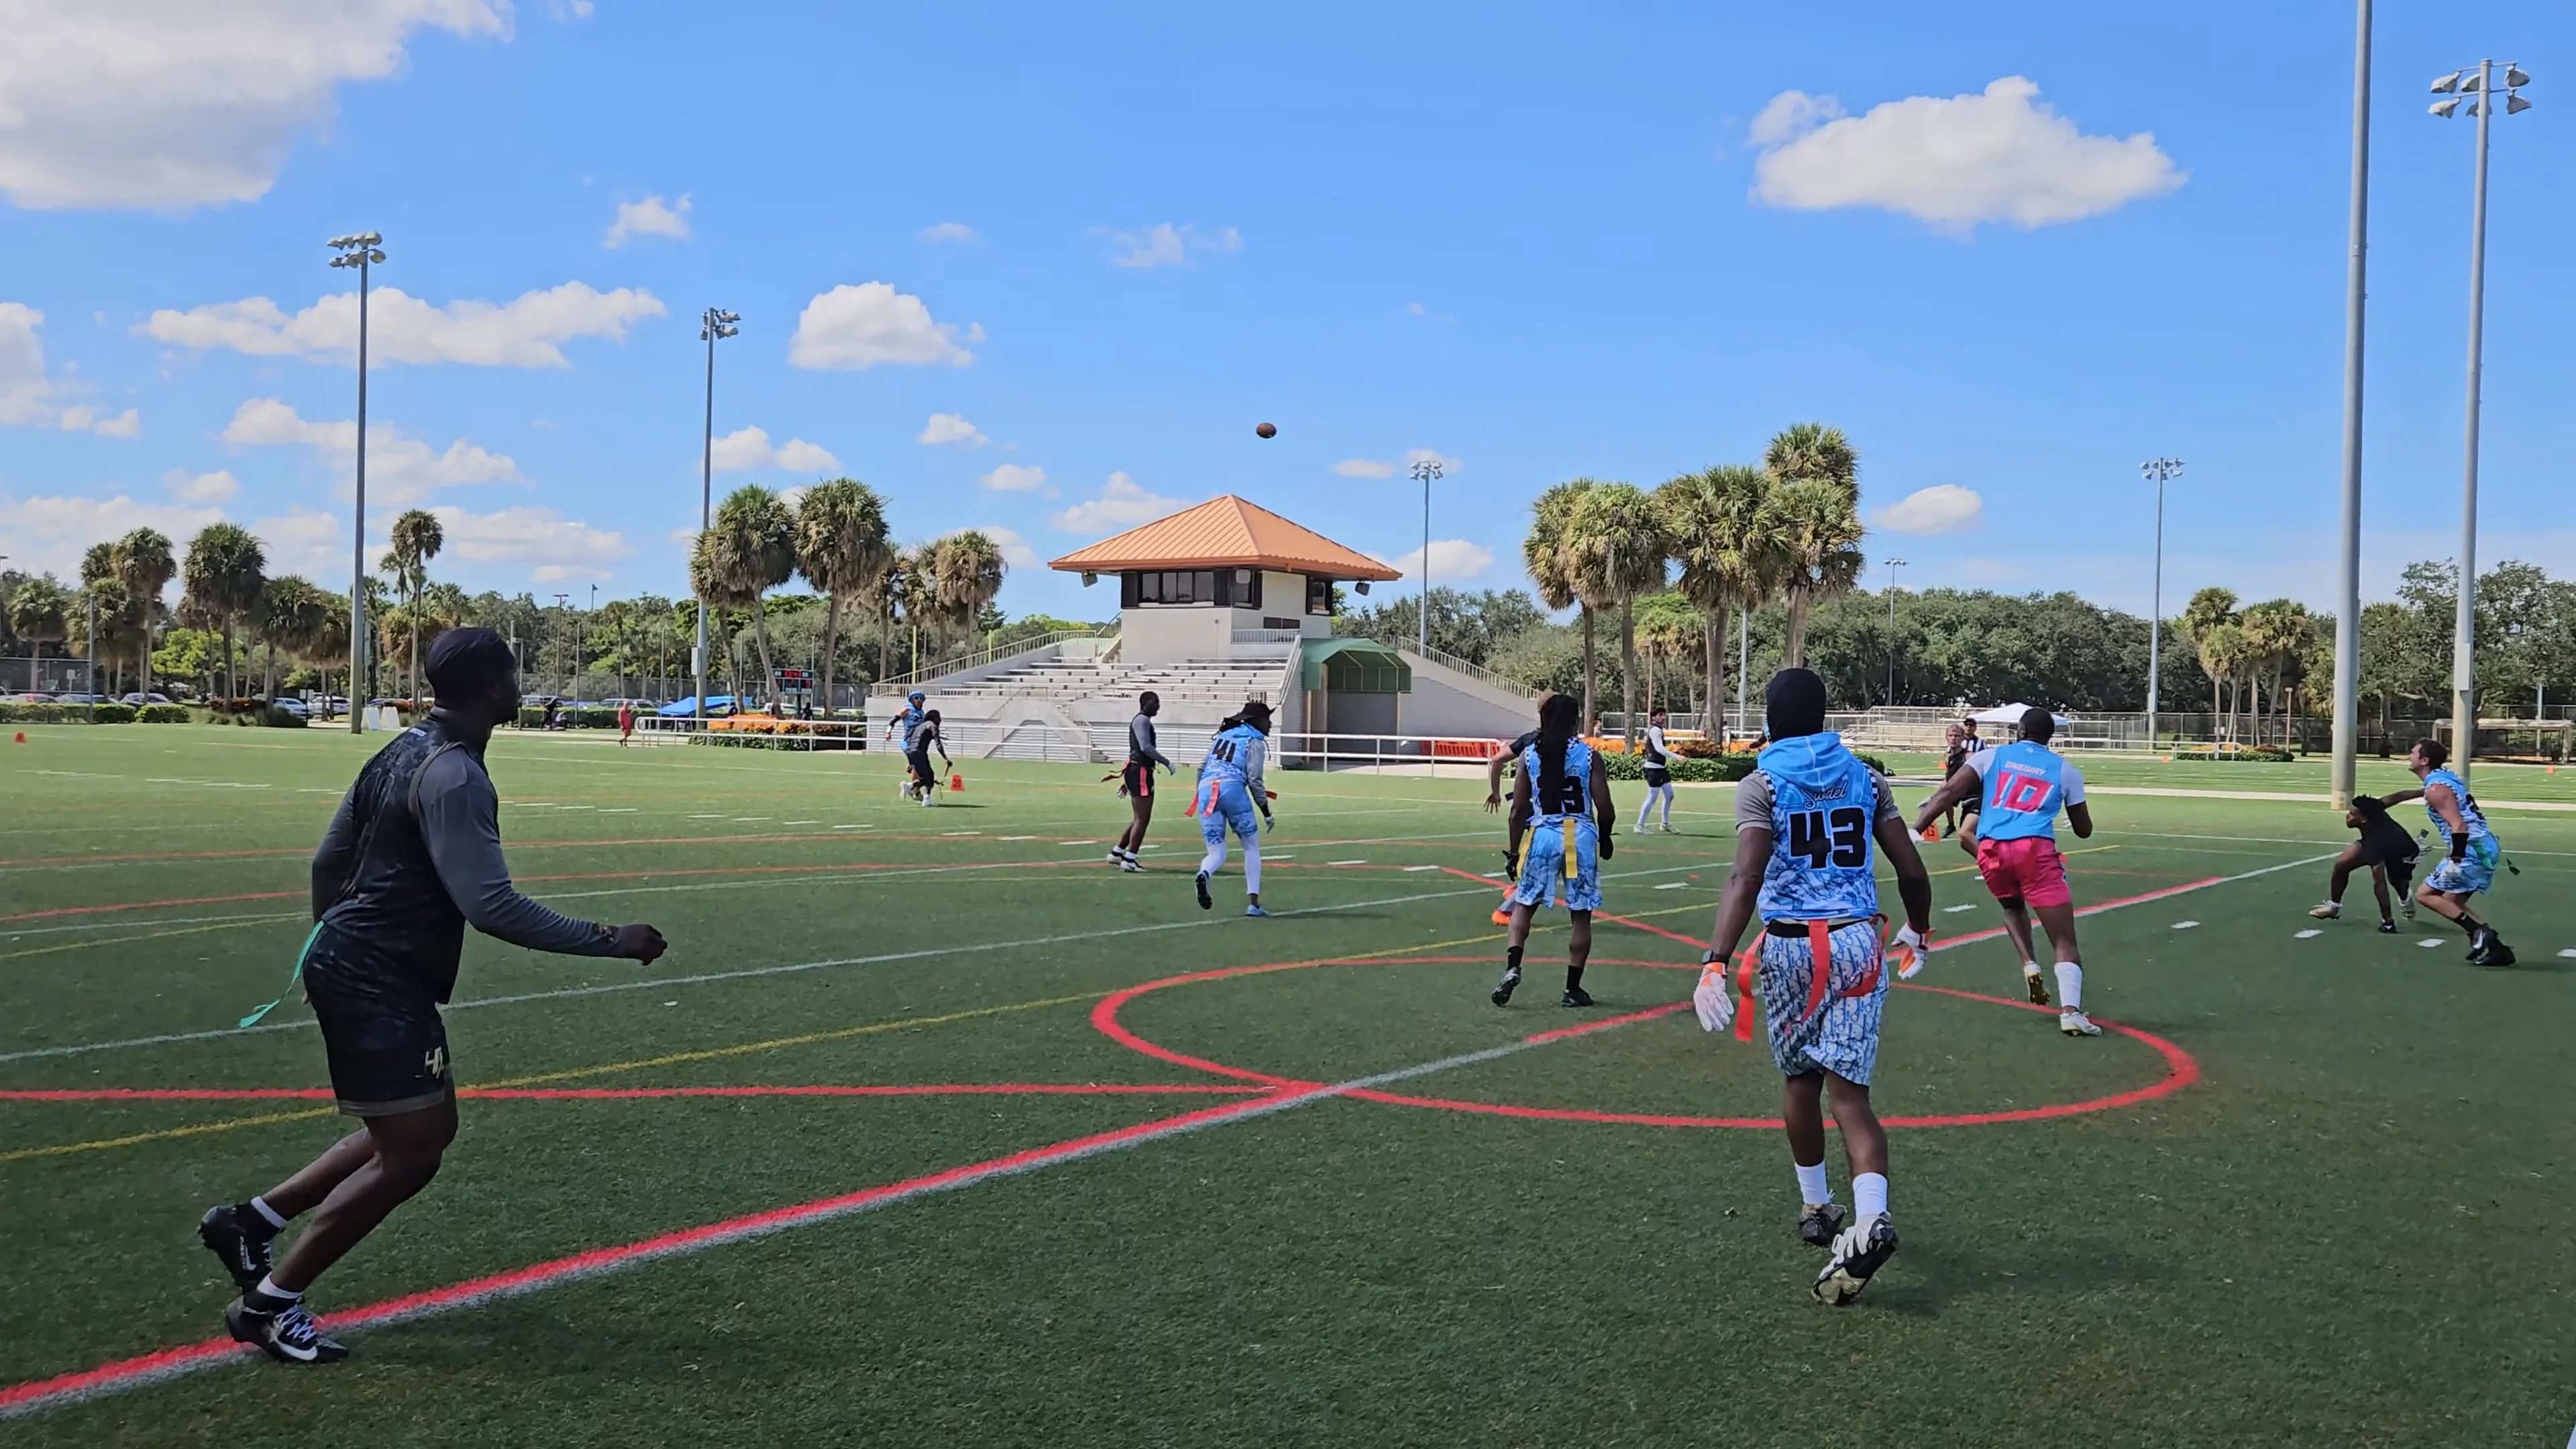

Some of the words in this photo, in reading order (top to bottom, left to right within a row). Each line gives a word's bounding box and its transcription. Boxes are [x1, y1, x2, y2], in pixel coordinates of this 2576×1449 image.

[1212, 738, 1237, 763] 41
[1537, 775, 1585, 815] 3
[1992, 770, 2055, 814] 10
[1788, 806, 1867, 869] 43
